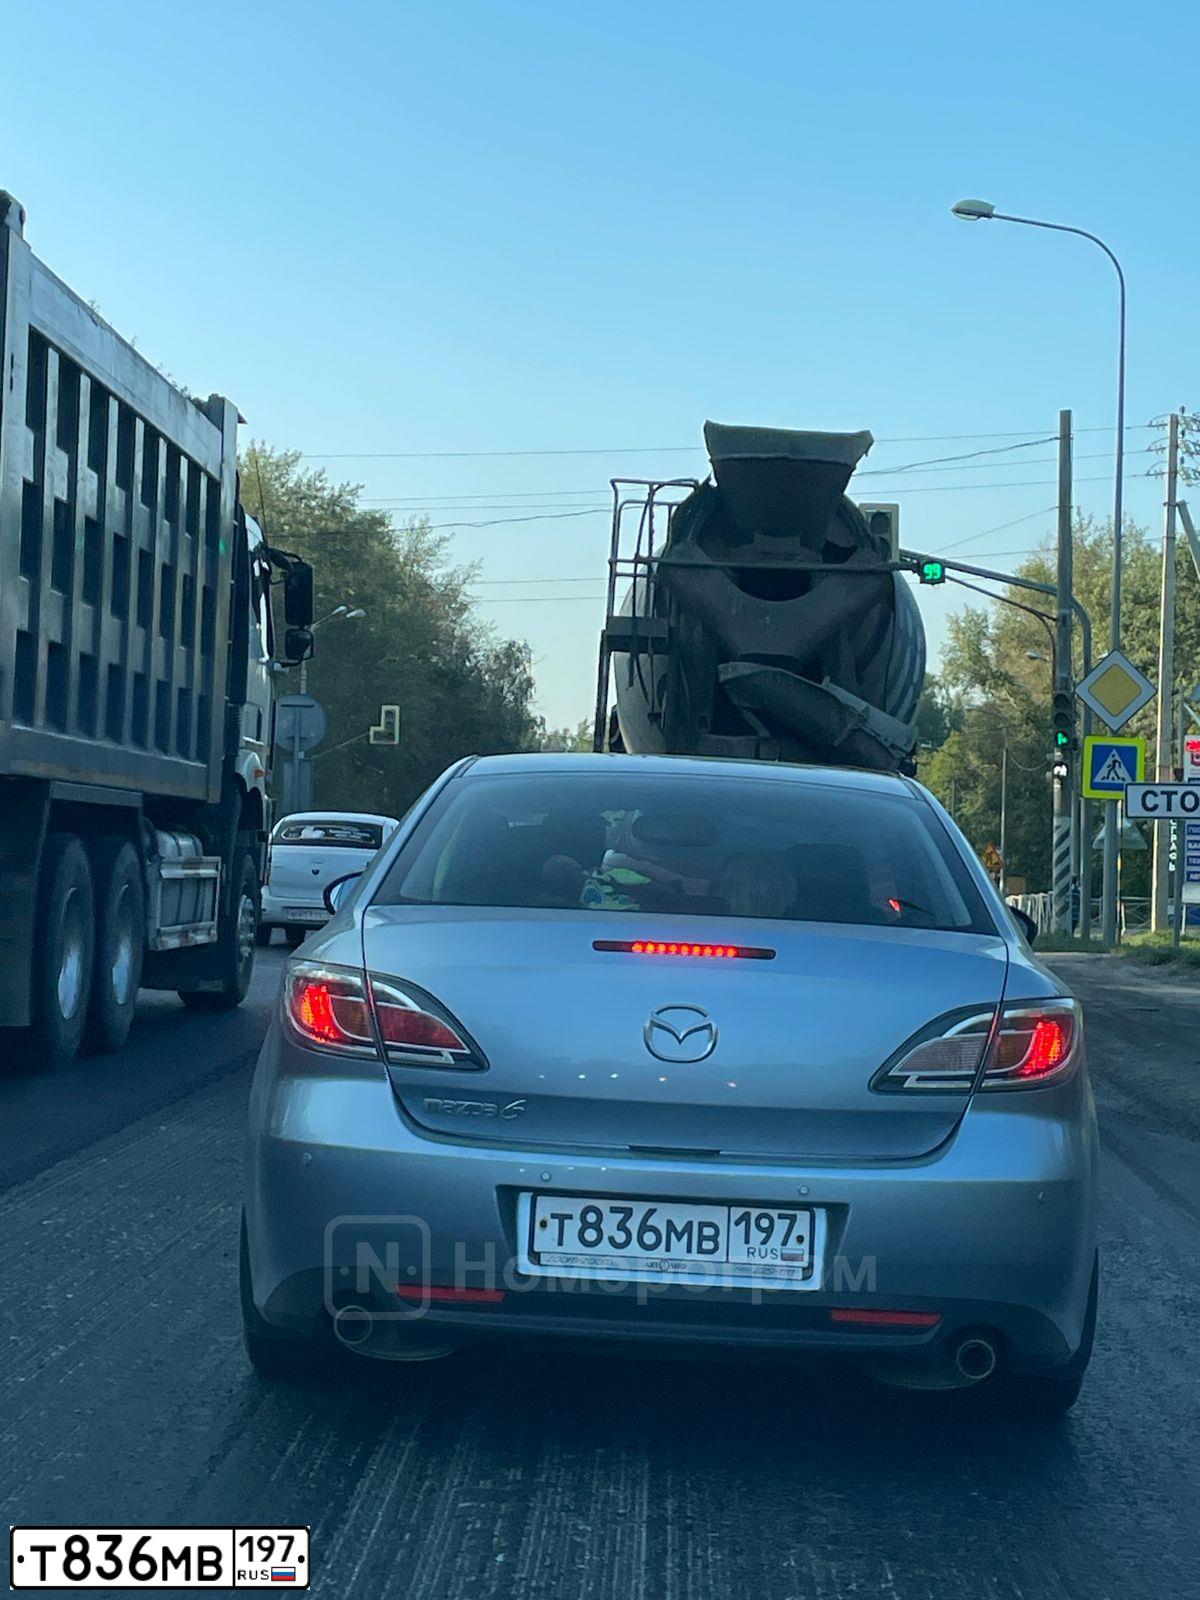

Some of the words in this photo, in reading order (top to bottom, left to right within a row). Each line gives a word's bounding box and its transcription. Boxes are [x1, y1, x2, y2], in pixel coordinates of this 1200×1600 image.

[923, 563, 942, 580] 99
[550, 1205, 720, 1255] Т836МВ
[734, 1211, 798, 1247] 197
[746, 1247, 779, 1260] RUS
